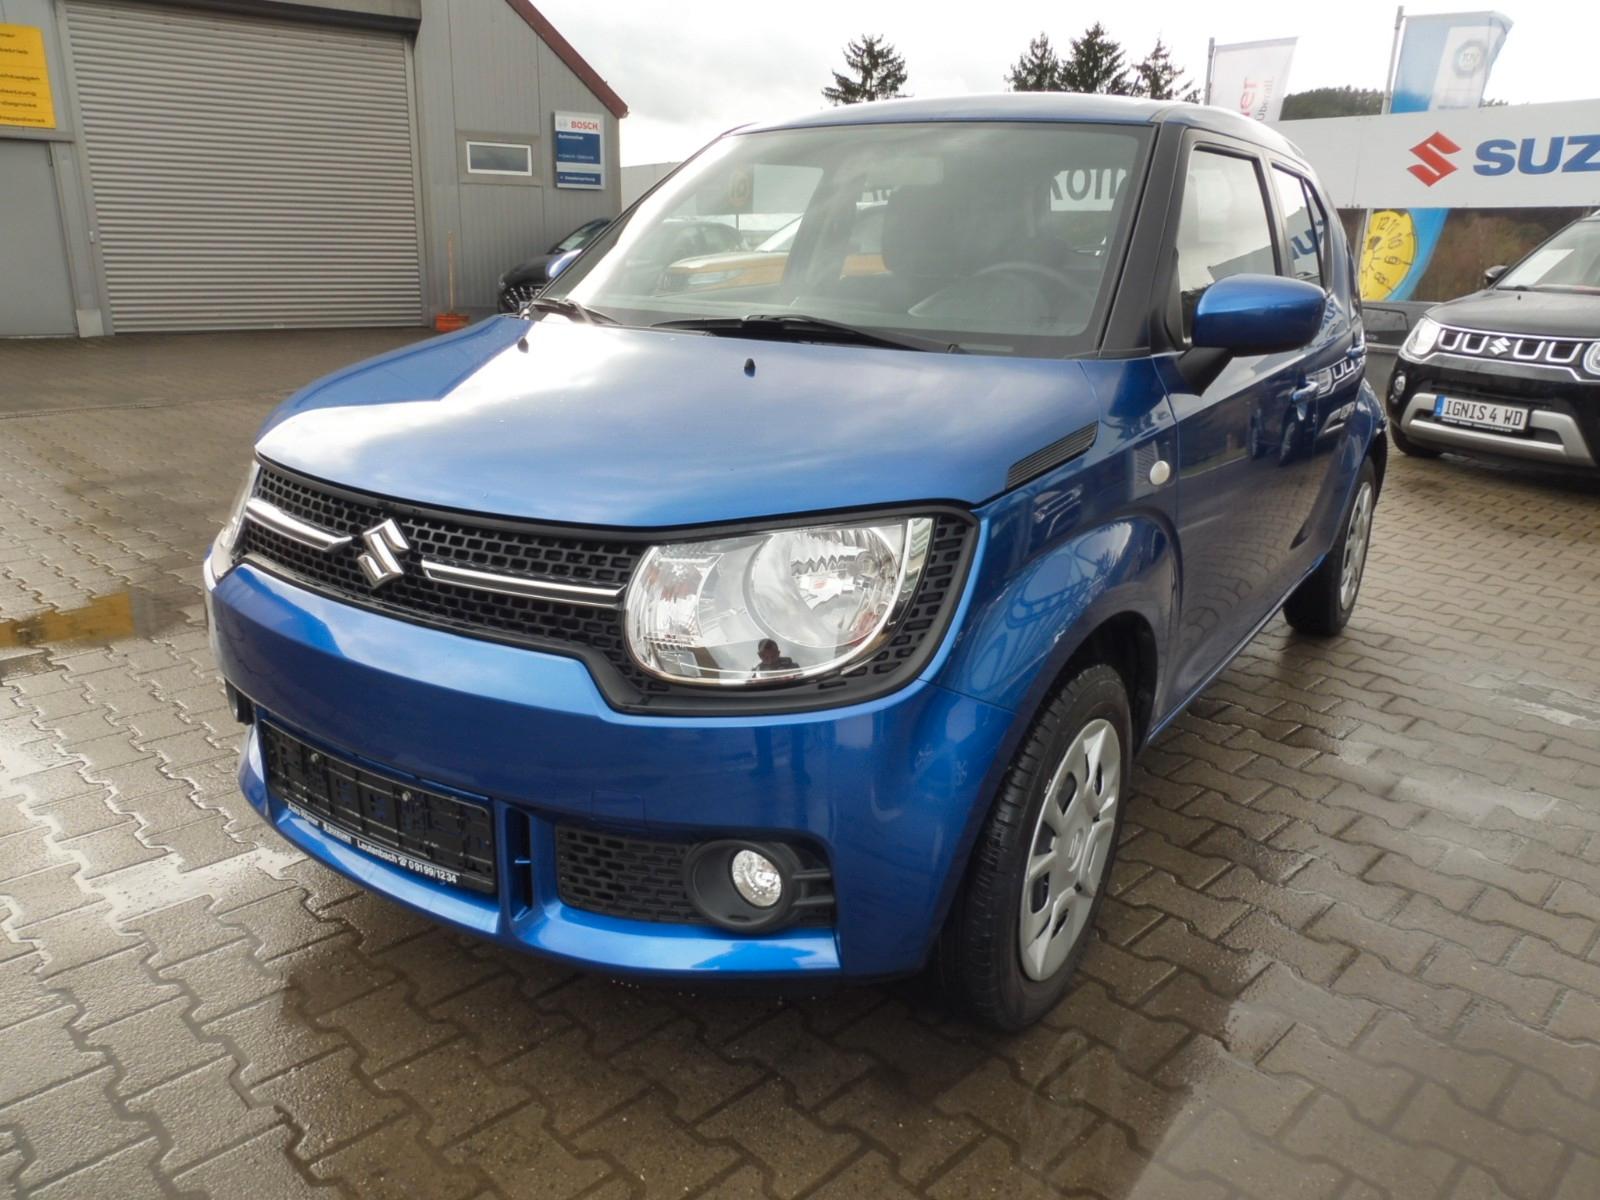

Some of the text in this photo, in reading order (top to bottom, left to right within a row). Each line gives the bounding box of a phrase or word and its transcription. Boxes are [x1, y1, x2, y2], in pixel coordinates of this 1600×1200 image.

[571, 121, 598, 130] BOSCH
[1473, 134, 1600, 177] SUZ
[1503, 409, 1523, 427] WD
